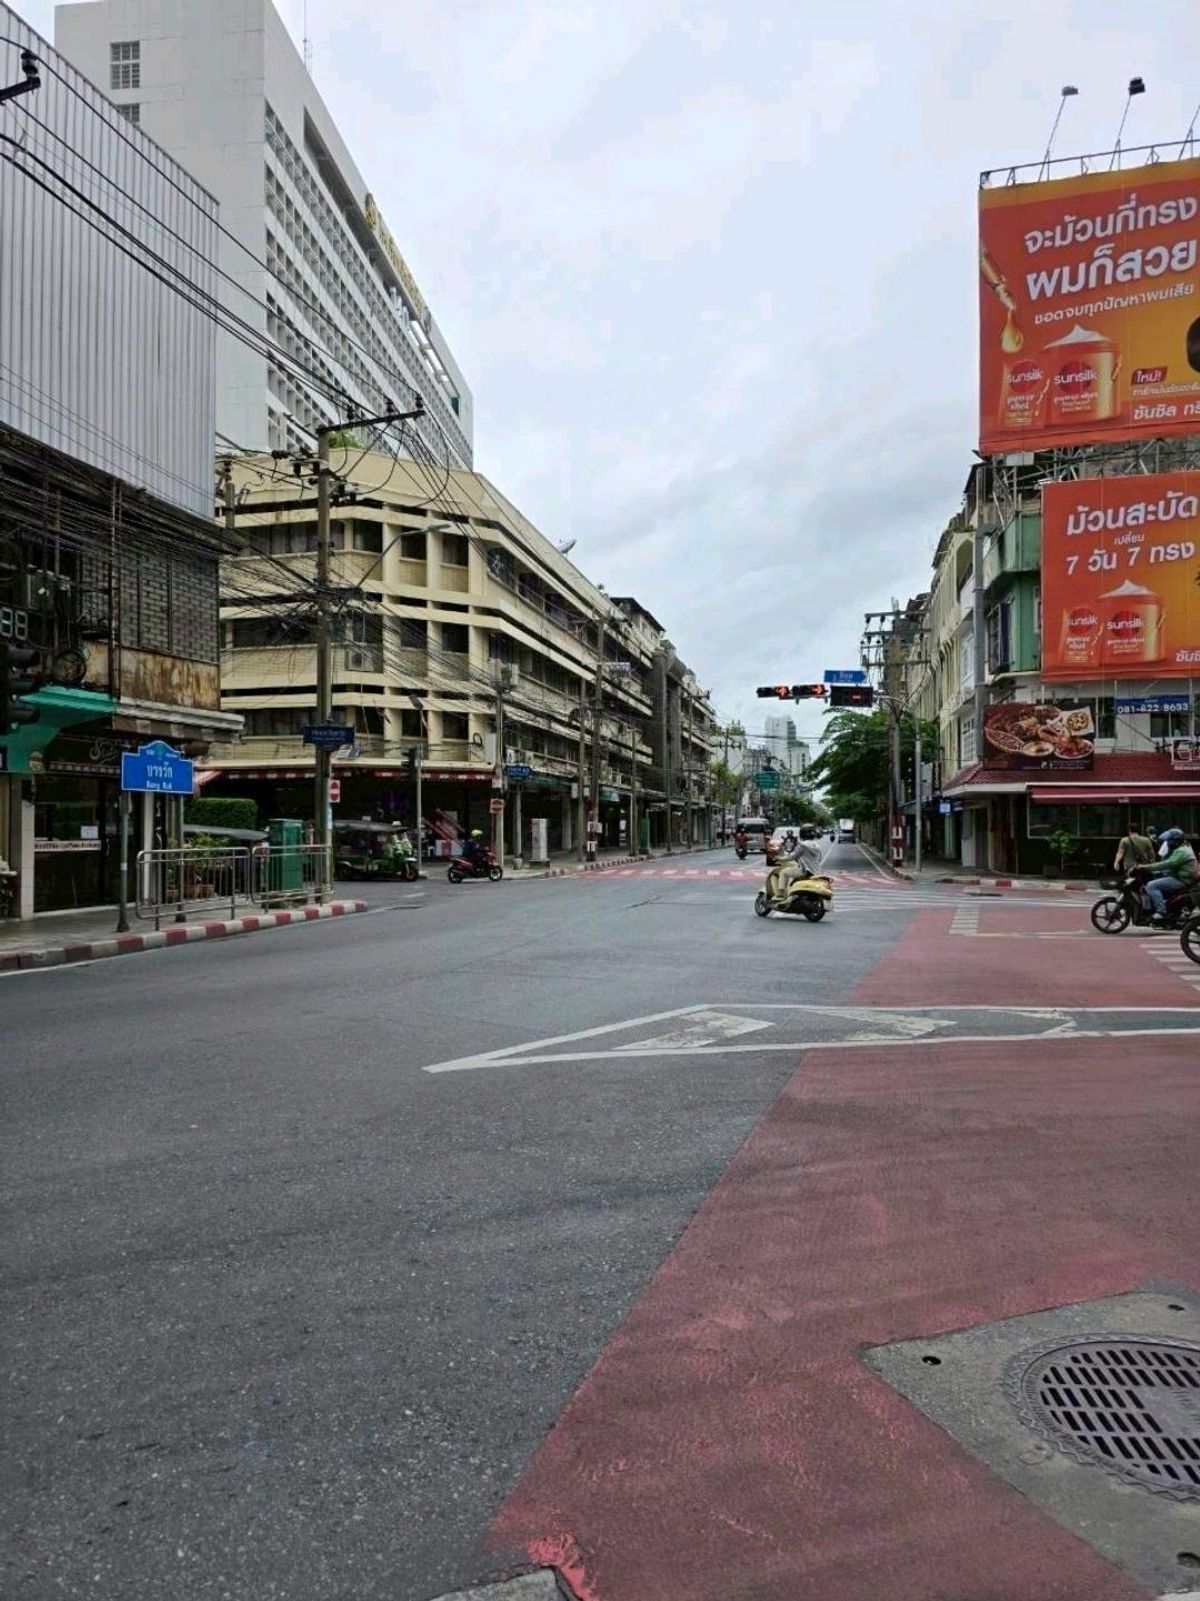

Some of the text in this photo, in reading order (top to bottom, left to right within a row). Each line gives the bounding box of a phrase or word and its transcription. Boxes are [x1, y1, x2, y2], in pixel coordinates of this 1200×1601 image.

[1024, 194, 1197, 253] จะม้วนกี่ทรง
[1026, 239, 1197, 301] ผมก็สวย
[1007, 368, 1044, 383] sunsilk
[1053, 369, 1098, 384] sunsilk
[1066, 490, 1198, 535] ม้วนสะบัด
[1066, 541, 1195, 576] 7 วัน 7 ทรง
[1106, 617, 1145, 630] sunsilk
